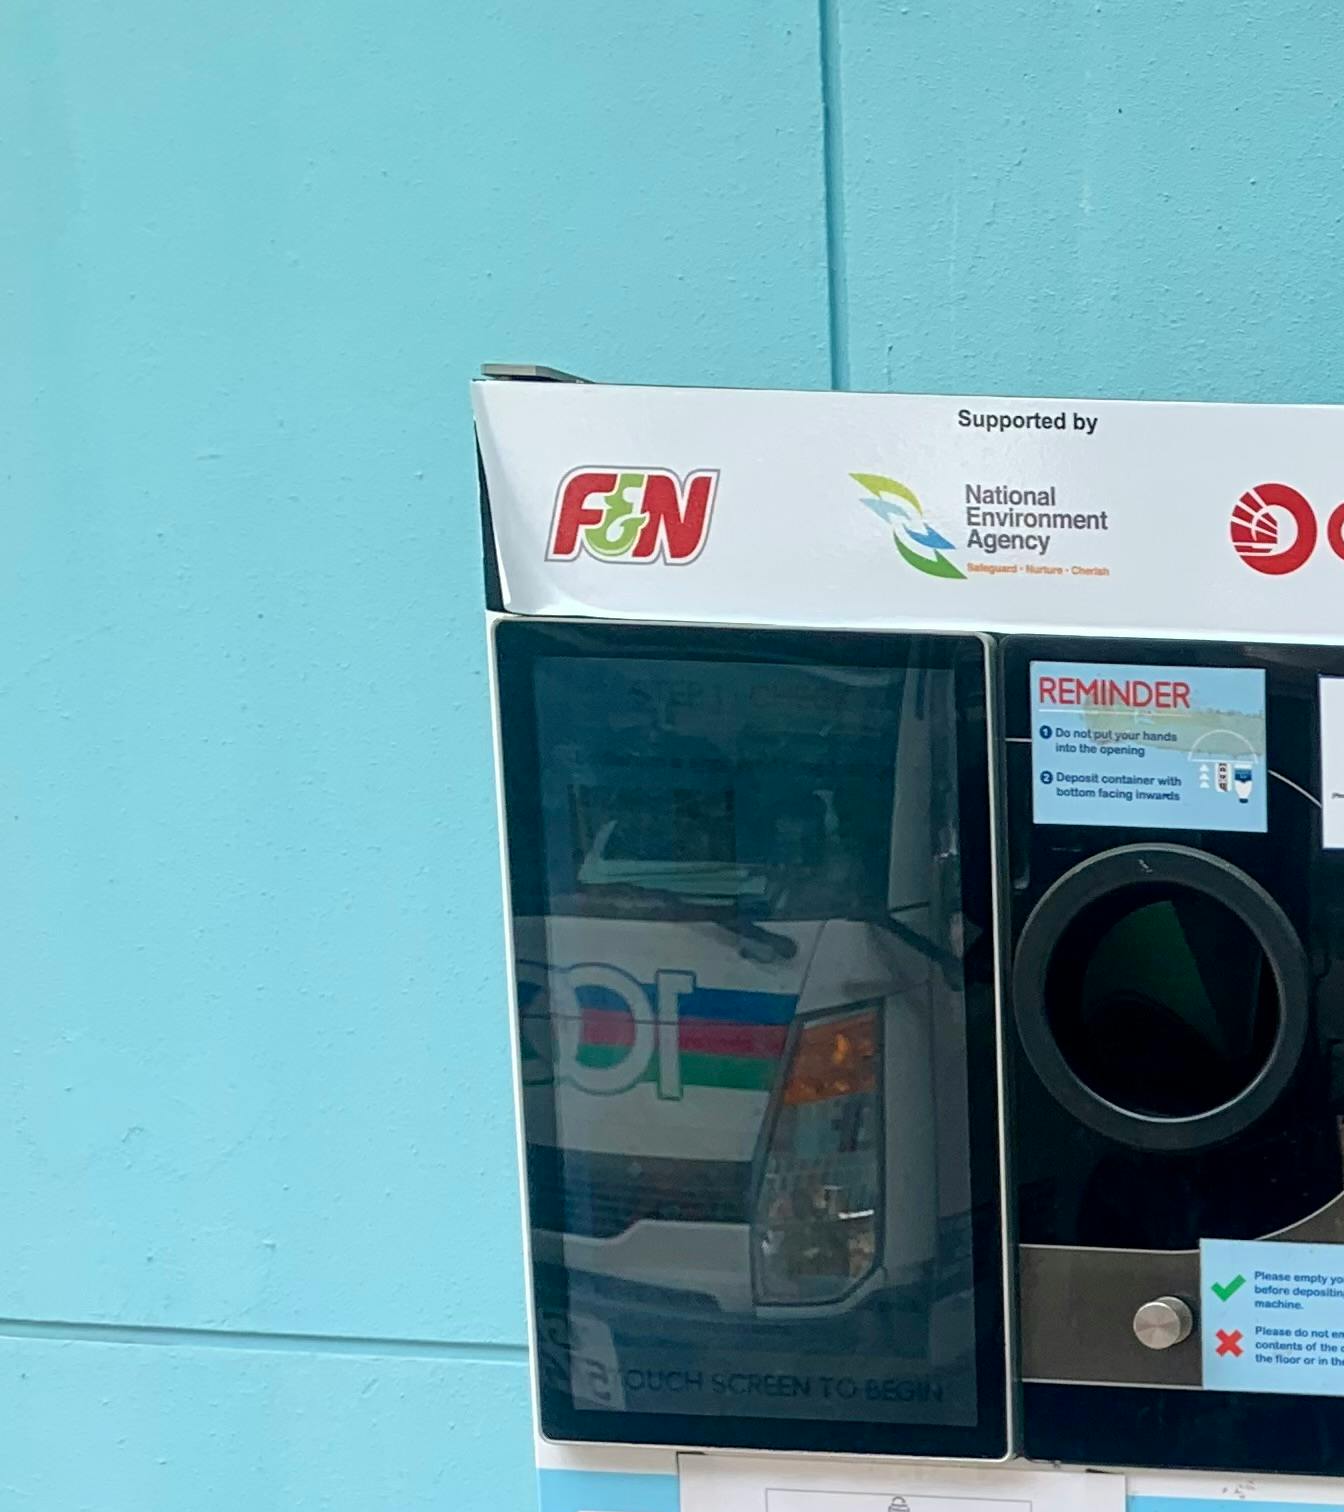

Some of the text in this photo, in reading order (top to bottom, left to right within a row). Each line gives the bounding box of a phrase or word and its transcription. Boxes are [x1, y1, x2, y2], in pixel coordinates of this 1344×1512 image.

[958, 409, 1098, 435] Supported by
[966, 485, 1056, 506] National
[550, 469, 714, 562] F&N
[966, 508, 1108, 531] Environment
[967, 530, 1051, 554] Agency
[1039, 677, 1190, 708] REMINDER
[1056, 728, 1177, 742] Do not put your hands
[1056, 743, 1145, 757] into the opening
[1057, 772, 1181, 786] Deposit container with
[1057, 788, 1180, 801] bottom facing inwards
[1255, 1271, 1291, 1281] Please
[1294, 1273, 1327, 1286] empty
[1255, 1285, 1290, 1296] before
[1255, 1300, 1304, 1310] machine.
[1255, 1326, 1292, 1337] Please
[1294, 1328, 1309, 1338] do
[1311, 1329, 1329, 1339] not
